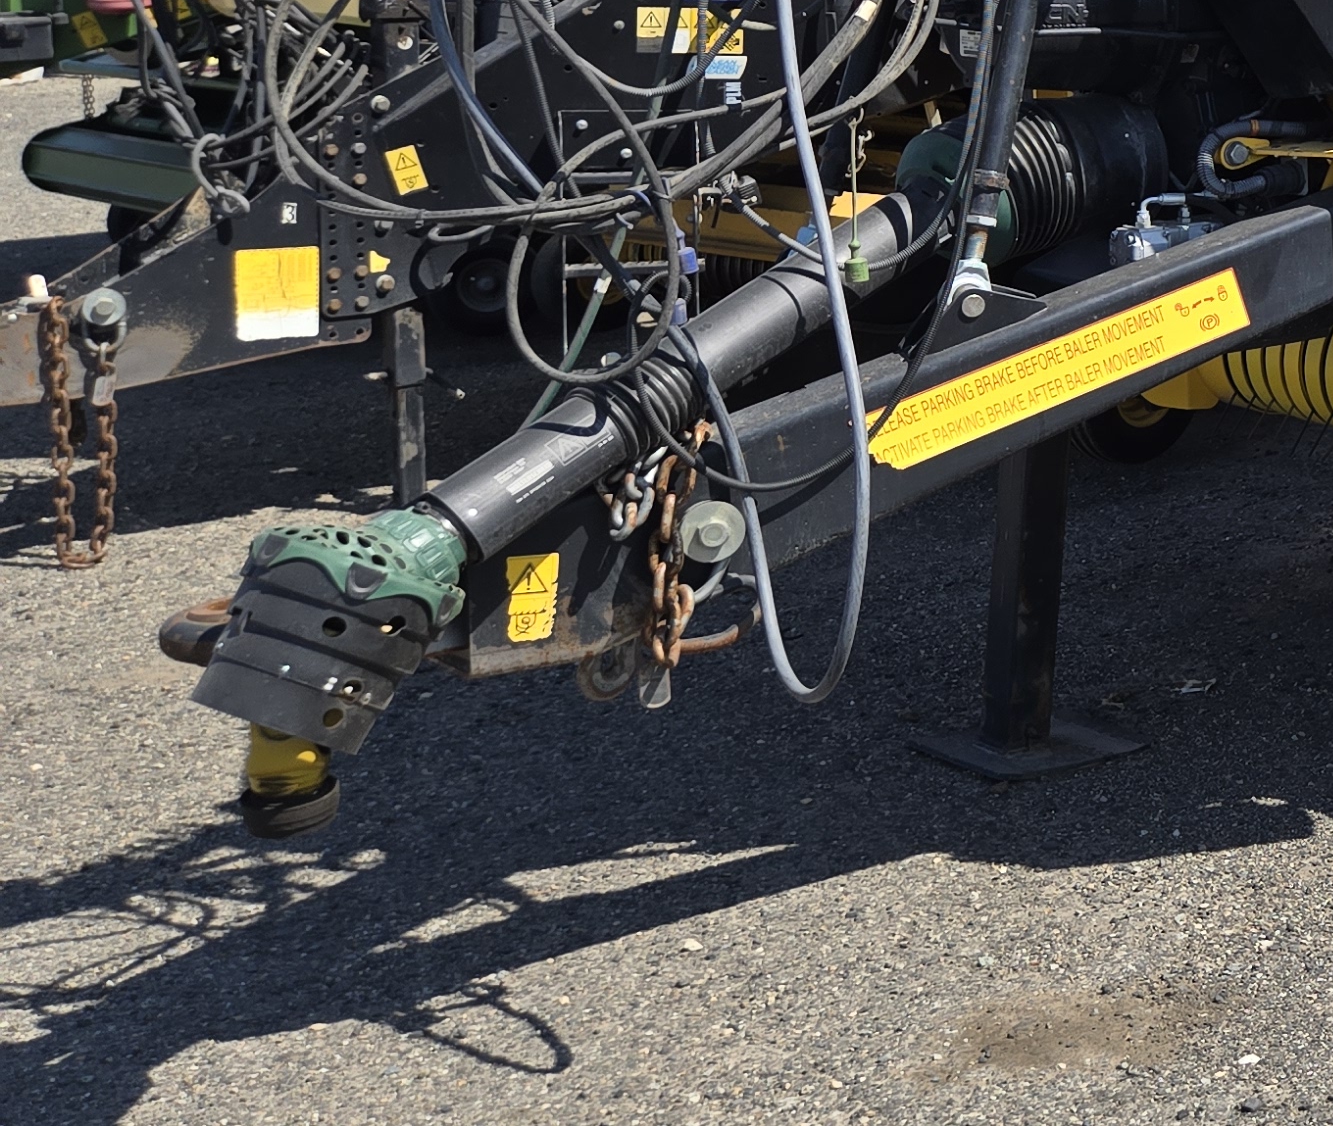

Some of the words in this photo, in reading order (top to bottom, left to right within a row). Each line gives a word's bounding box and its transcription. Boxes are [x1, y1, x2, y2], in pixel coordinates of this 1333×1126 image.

[867, 405, 919, 438] LEASE
[921, 382, 975, 415] PARKING
[975, 365, 1017, 396] BRAKE
[1017, 346, 1065, 379] BEFORE
[1063, 331, 1103, 360] BALER
[1102, 304, 1166, 345] MOVEMENT
[932, 410, 986, 443] PARKING
[987, 393, 1028, 424] BRAKE
[1028, 376, 1065, 409] AFTER
[1065, 362, 1104, 391] BALER
[1102, 335, 1166, 375] MOVEMENT
